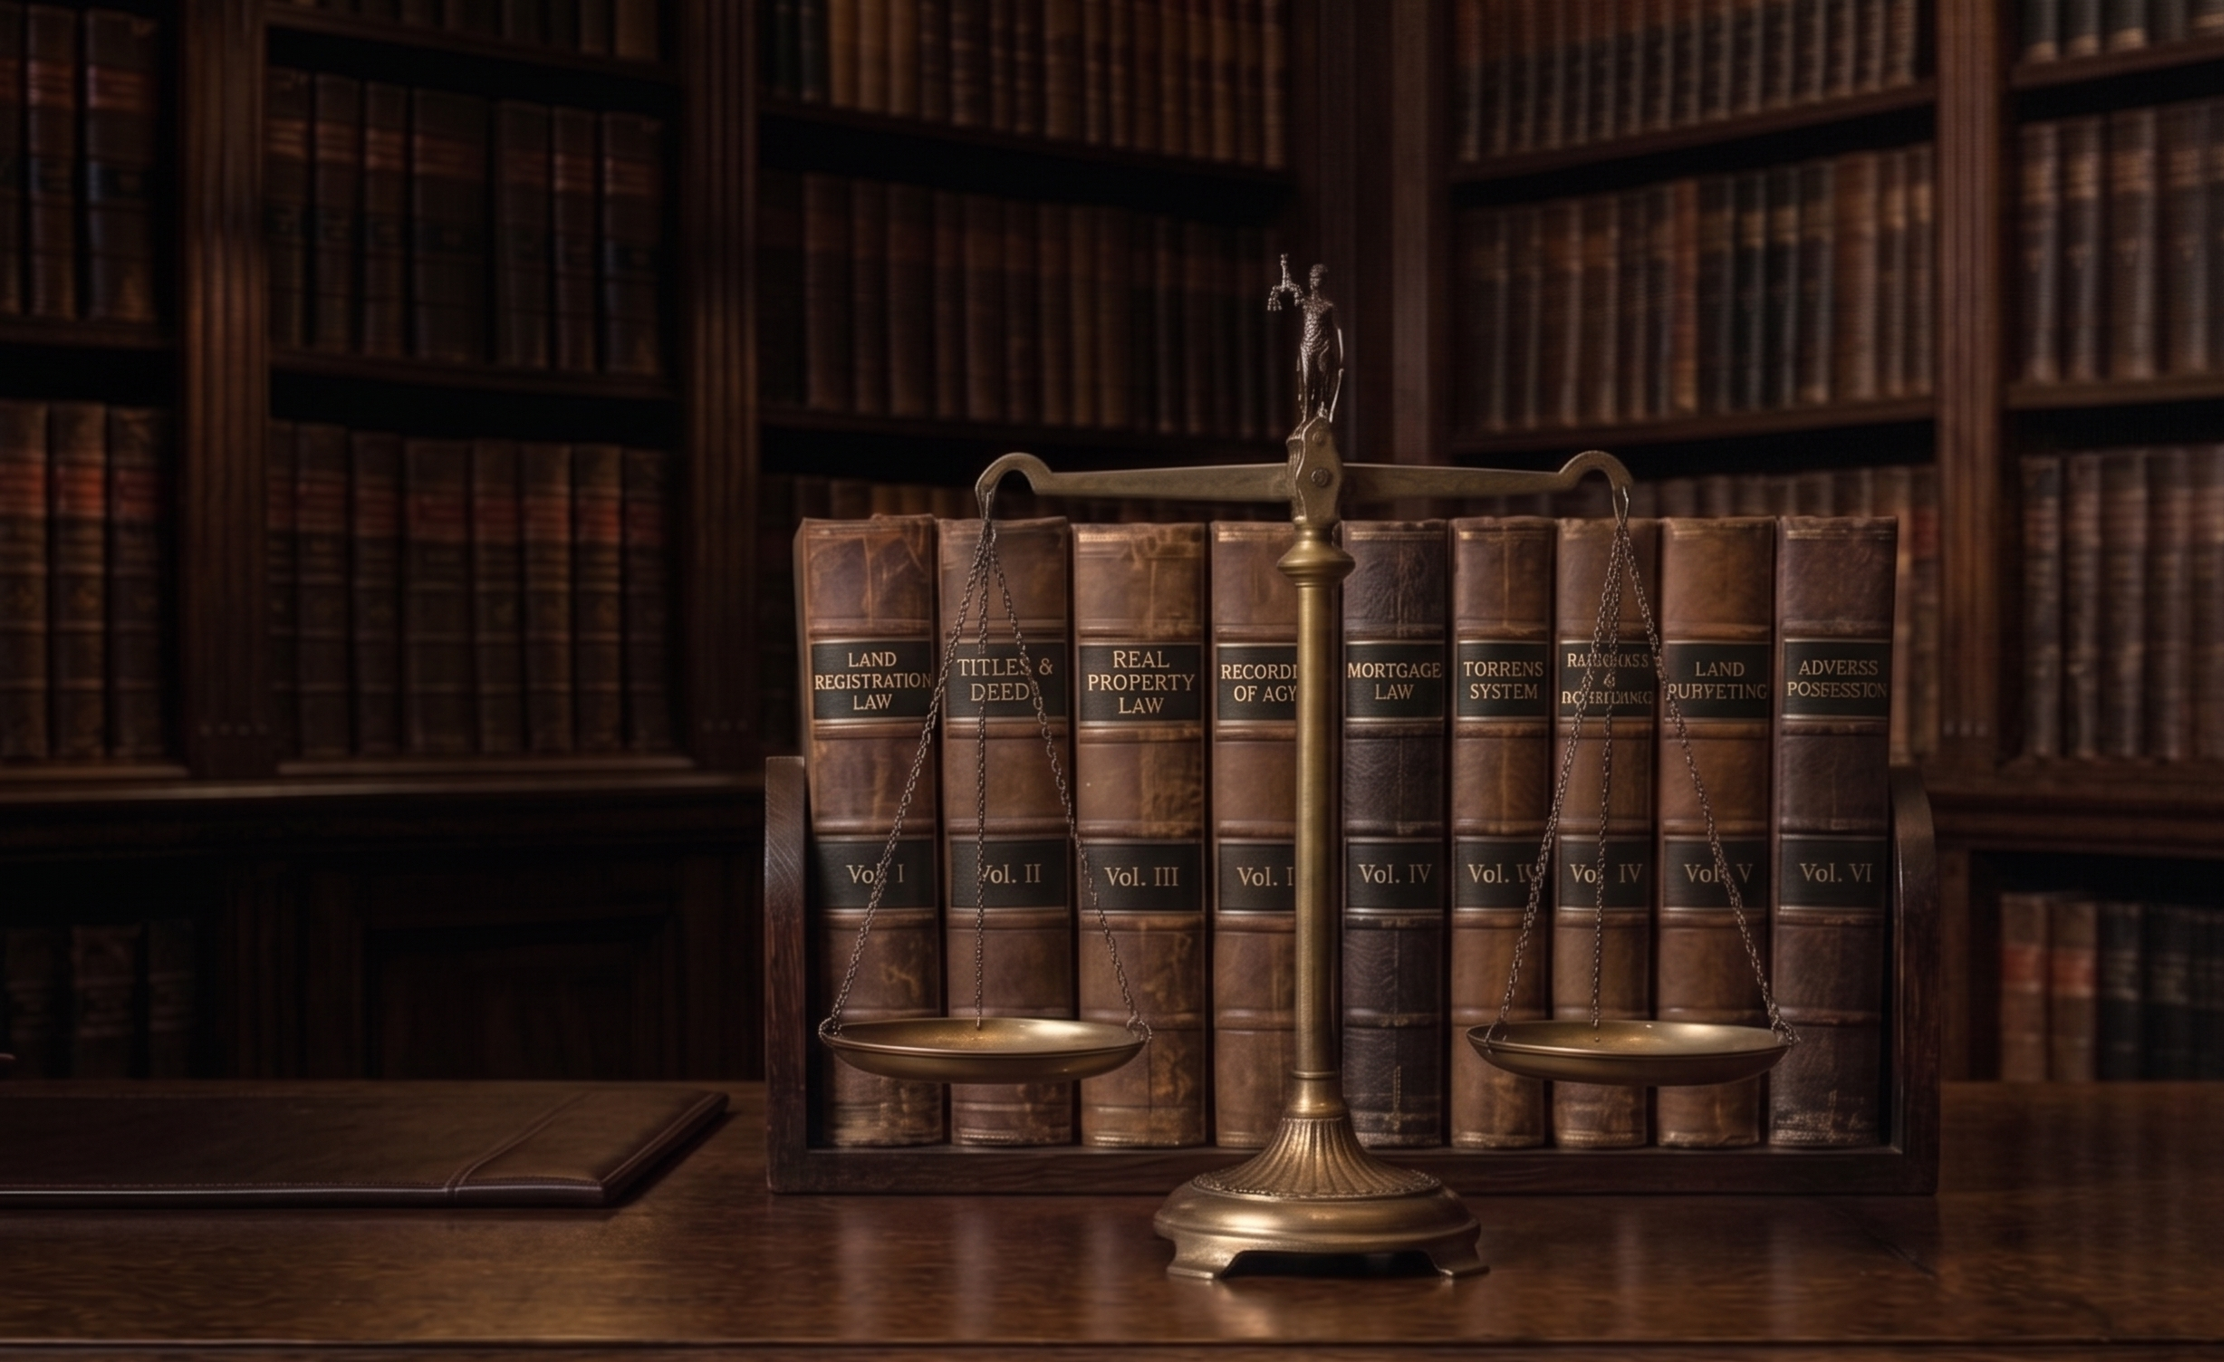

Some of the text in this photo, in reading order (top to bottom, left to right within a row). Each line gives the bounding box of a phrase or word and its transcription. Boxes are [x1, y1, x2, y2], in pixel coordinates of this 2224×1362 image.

[846, 651, 898, 668] LAND
[957, 657, 1053, 677] TITLES &
[1113, 650, 1170, 669] REAL
[1463, 660, 1544, 677] TORRENS
[1694, 661, 1746, 677] LAND
[1798, 660, 1879, 676] ADVERSS
[1347, 662, 1442, 679] MORTGAGE
[814, 672, 932, 690] REGISTRATION
[1088, 673, 1195, 692] PROPERTY
[1233, 684, 1258, 702] OF
[1374, 683, 1415, 701] LAW
[1469, 683, 1538, 700] SYSTEM
[852, 693, 893, 711] LAW
[1118, 696, 1165, 714] LAW
[896, 863, 905, 883] I
[1024, 863, 1042, 884] II
[1104, 866, 1179, 887] Vol. III
[1237, 866, 1278, 887] Vol.
[1358, 863, 1433, 884] Vol. IV
[1467, 863, 1510, 884] Vol.
[1618, 863, 1643, 884] IV
[1736, 863, 1754, 884] V
[1799, 863, 1873, 884] Vol. VI
